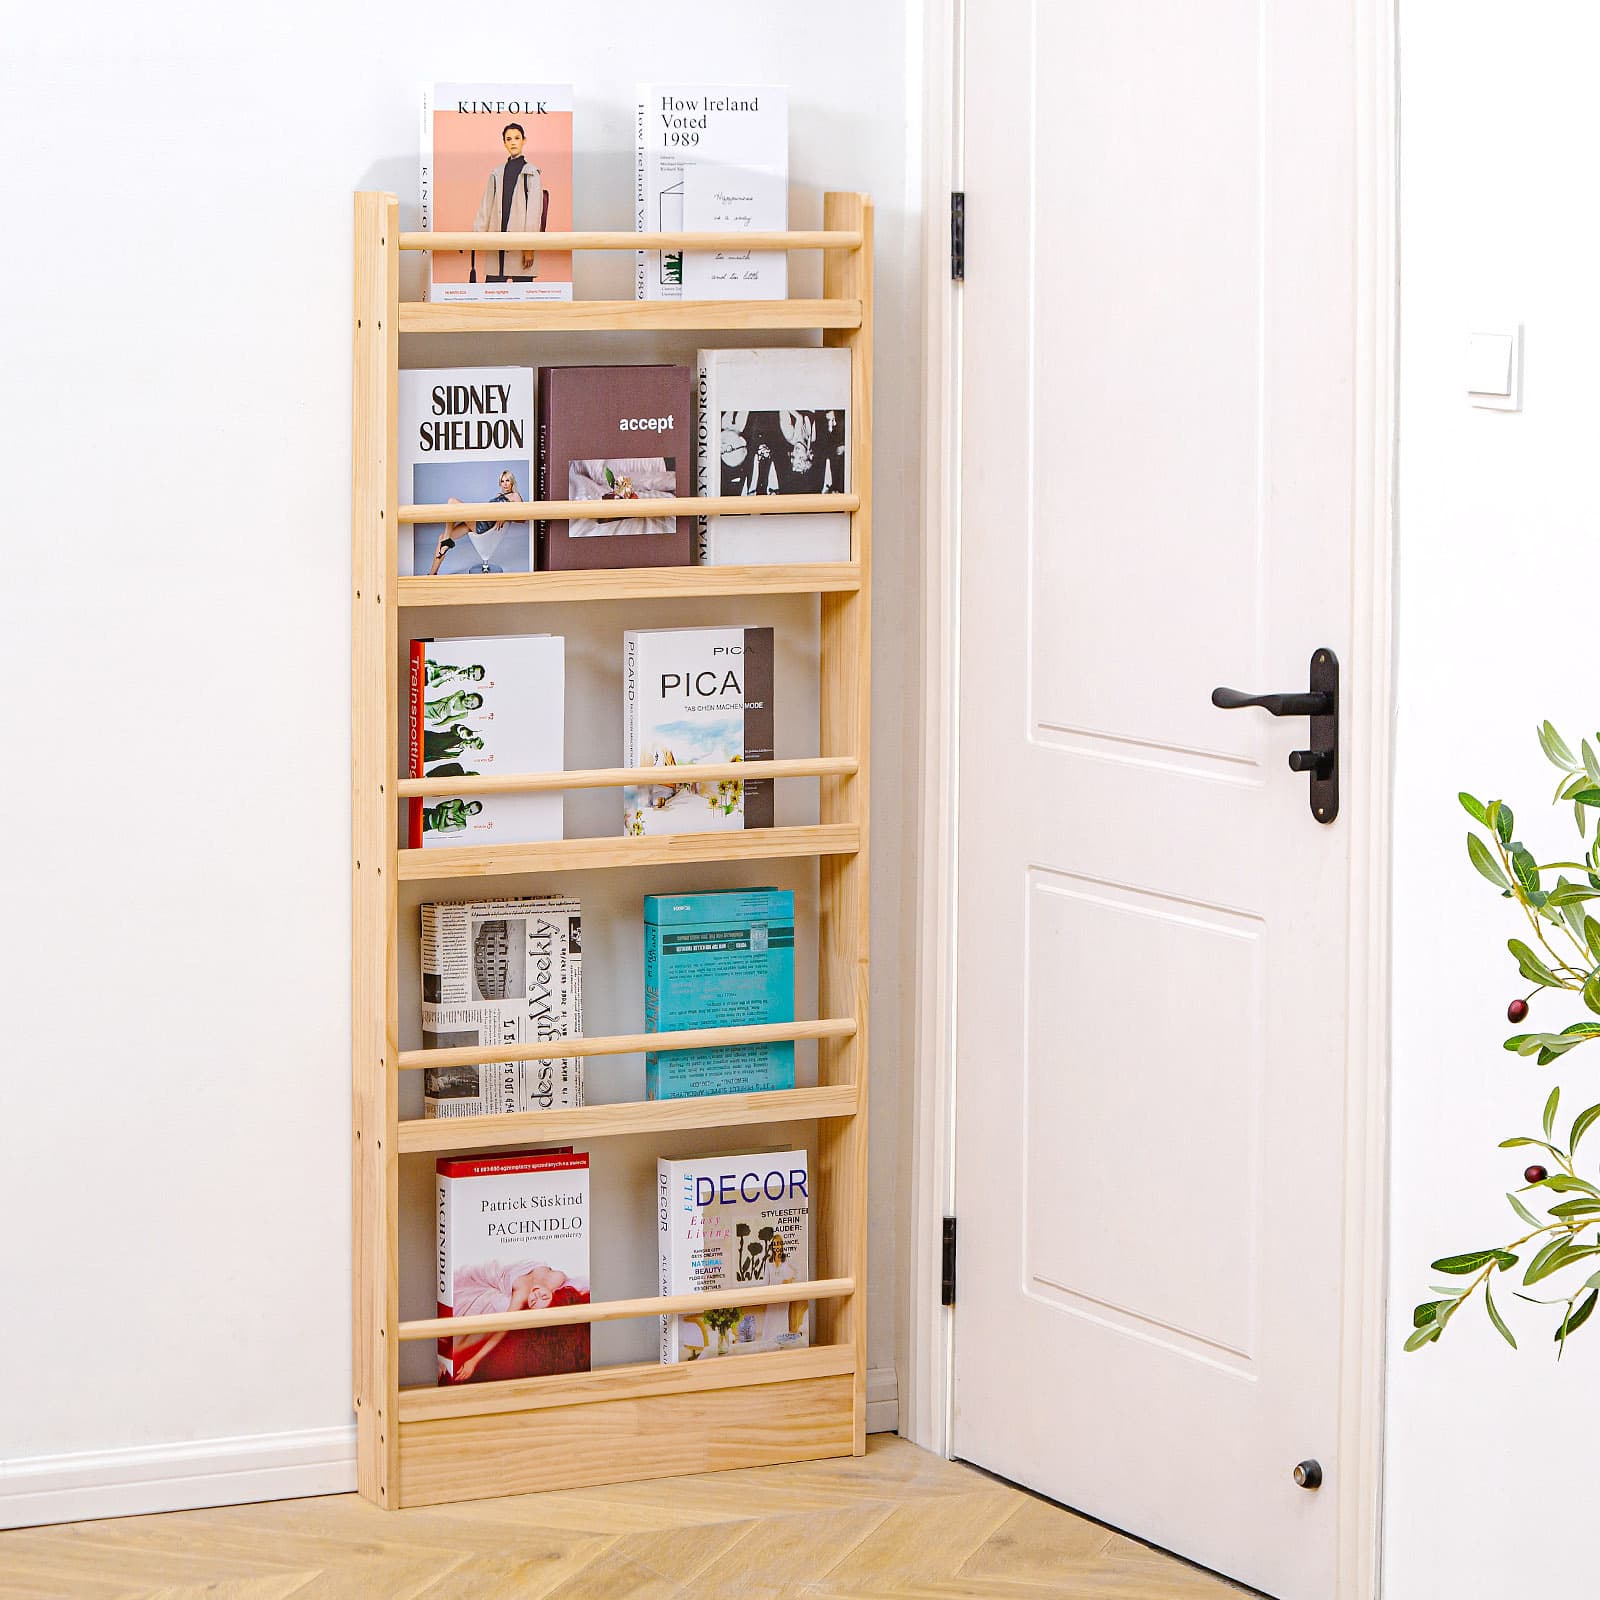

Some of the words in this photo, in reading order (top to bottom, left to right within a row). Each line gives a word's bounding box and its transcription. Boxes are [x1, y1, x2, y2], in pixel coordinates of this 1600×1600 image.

[458, 101, 549, 115] KINFOLK
[661, 96, 699, 111] How
[704, 96, 759, 111] Ireland
[661, 114, 707, 129] Voted
[662, 132, 700, 147] 1989
[431, 384, 511, 416] SIDNEY
[698, 367, 708, 459] MONROE
[619, 414, 674, 433] accept
[419, 418, 524, 451] SHELDON
[698, 466, 708, 560] MARYN
[661, 670, 741, 698] PICA
[696, 1169, 809, 1207] DECOR
[481, 1196, 527, 1212] Patrick
[531, 1192, 583, 1208] Süskind
[660, 1174, 668, 1232] DECOR
[488, 1216, 582, 1236] PACHNIDLO
[690, 1215, 721, 1226] Easy
[777, 1216, 800, 1225] AERIN
[686, 1229, 731, 1240] Living
[691, 1259, 724, 1268] NATURAL
[695, 1267, 722, 1275] BEAUTY
